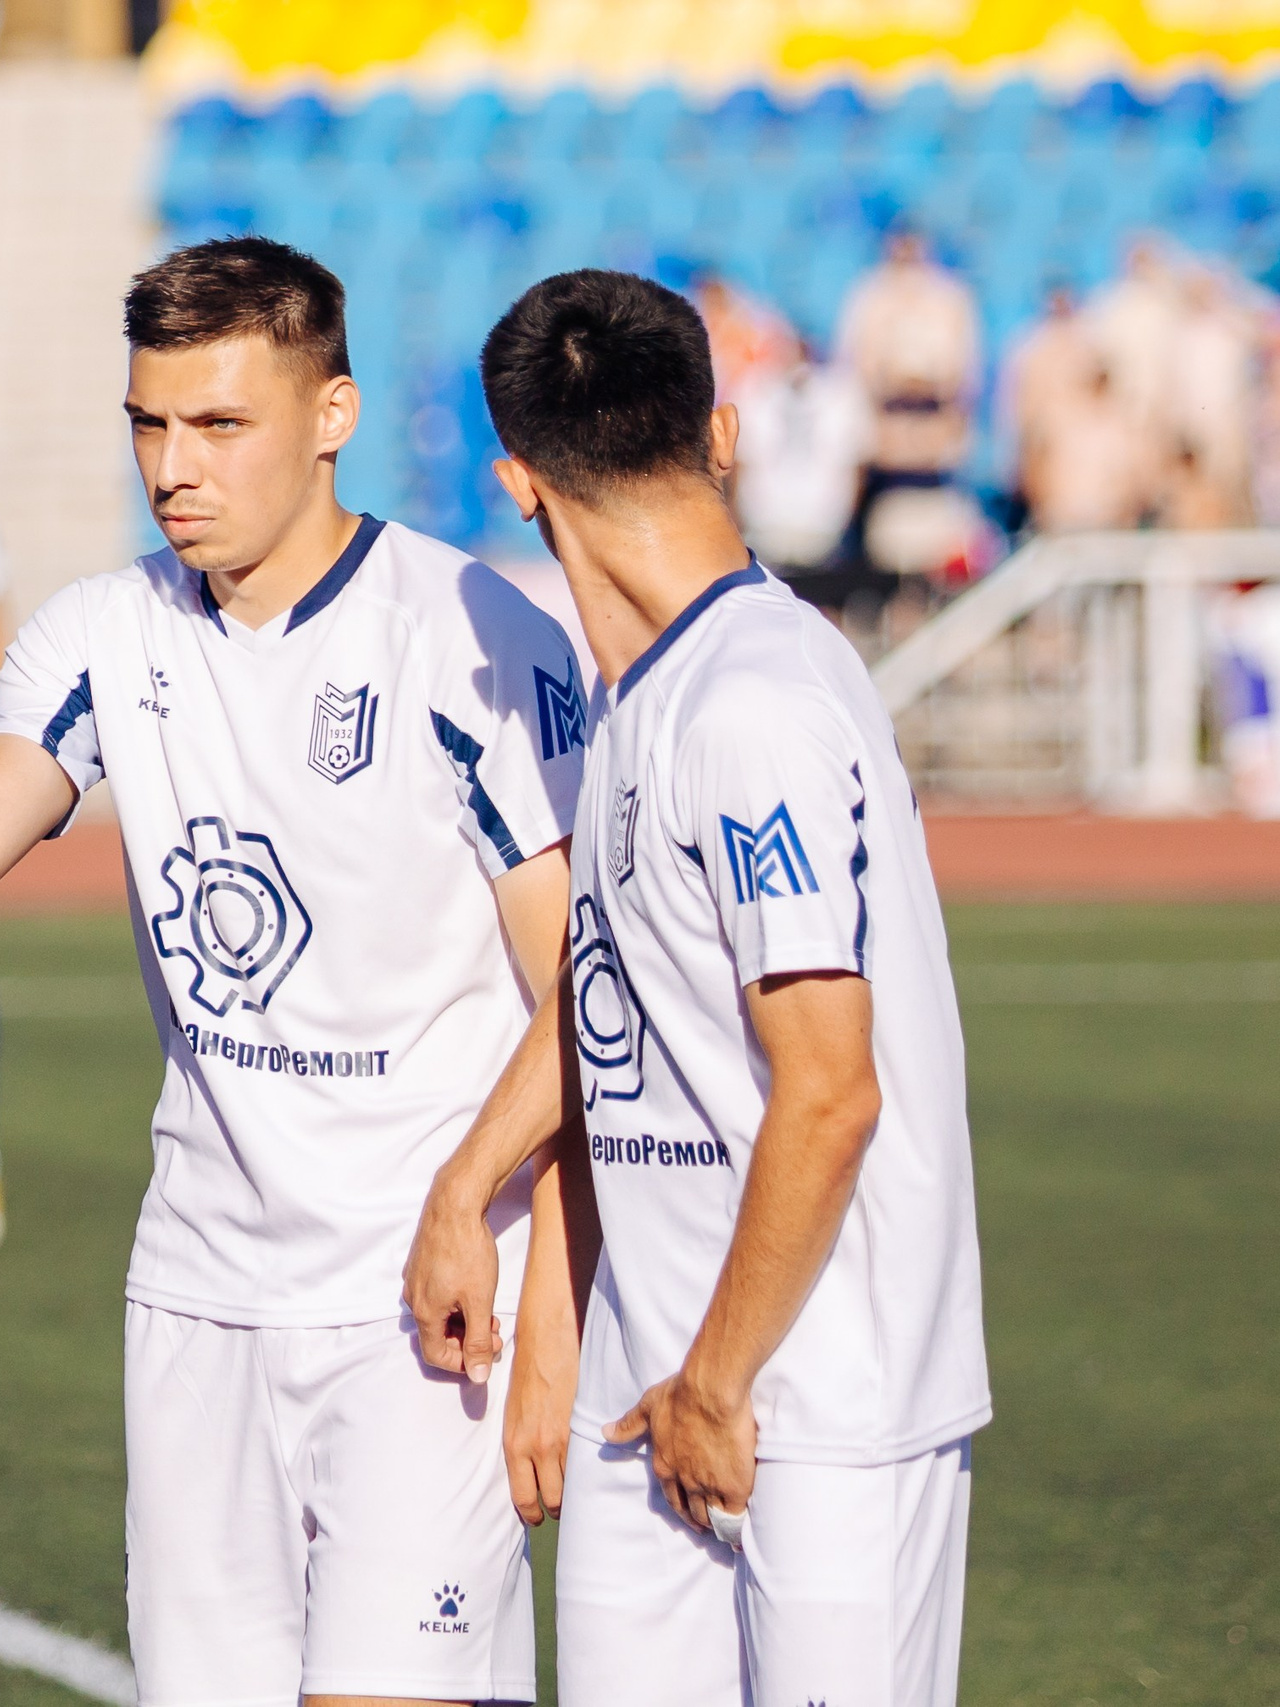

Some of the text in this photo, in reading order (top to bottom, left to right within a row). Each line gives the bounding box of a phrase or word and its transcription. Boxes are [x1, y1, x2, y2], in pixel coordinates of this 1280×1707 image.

[138, 697, 170, 719] KEE
[330, 728, 353, 739] 1932
[172, 1014, 390, 1077] ЭнергоРемонт
[587, 1132, 732, 1168] ергоРемон
[419, 1620, 471, 1634] KELME
